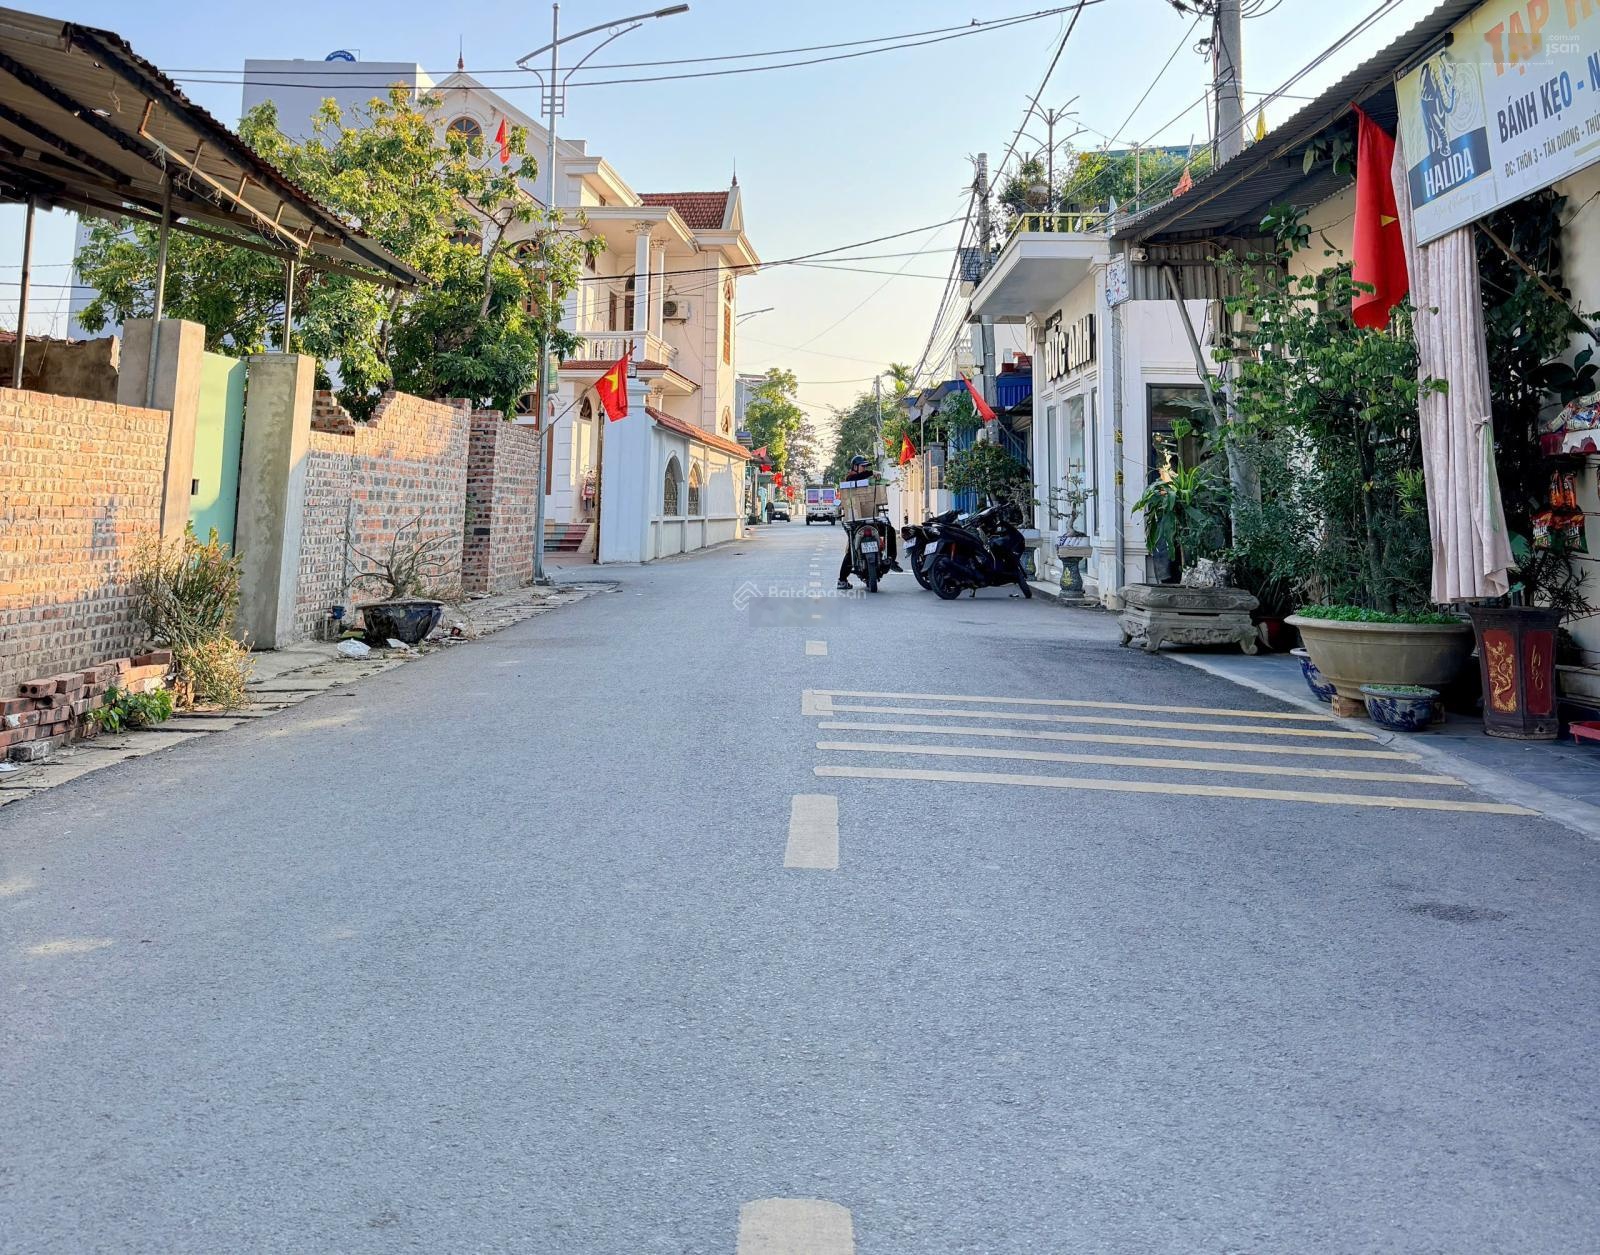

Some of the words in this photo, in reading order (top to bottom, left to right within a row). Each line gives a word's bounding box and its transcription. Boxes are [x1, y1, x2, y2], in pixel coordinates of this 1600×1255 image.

[1497, 96, 1539, 144] BÁNH
[1540, 71, 1573, 123] KẸO
[1424, 147, 1475, 198] HALIDA
[1516, 148, 1534, 172] THÔN
[1533, 147, 1539, 164] 3
[1543, 136, 1557, 158] TÂN
[1557, 125, 1581, 152] DƯƠNG
[1068, 313, 1093, 370] ANH
